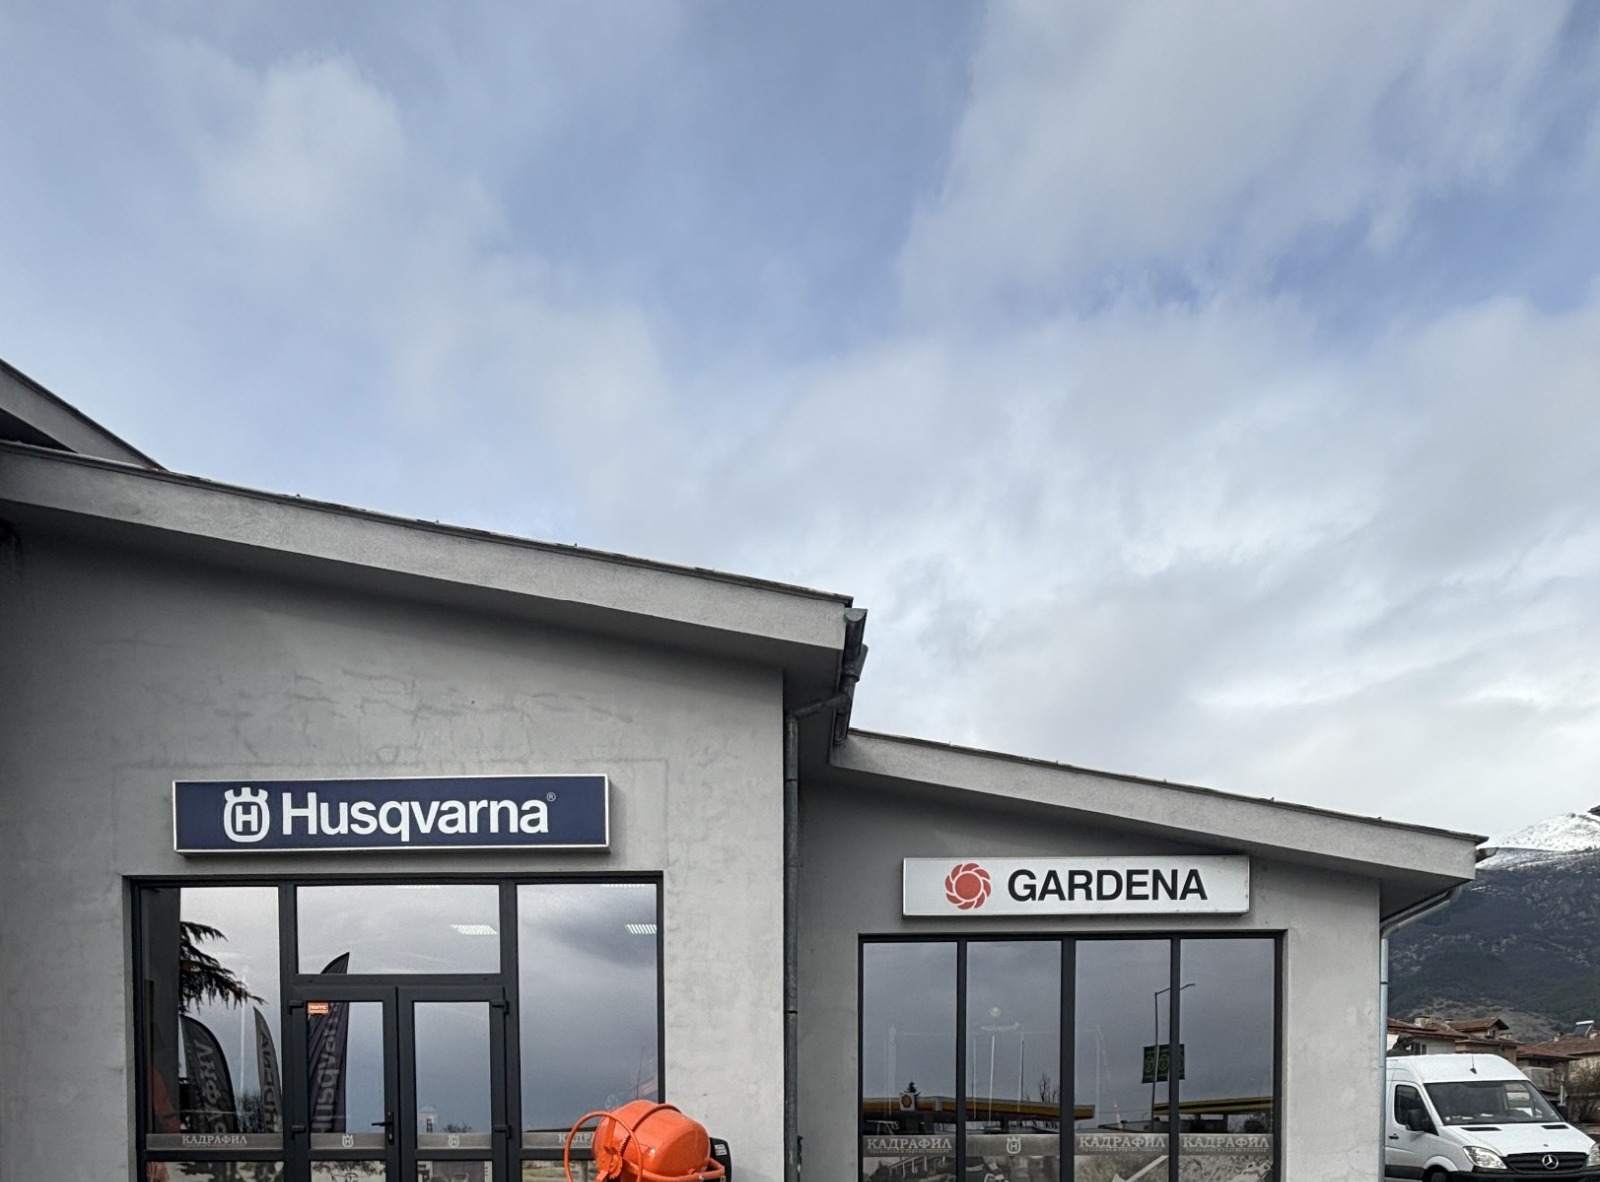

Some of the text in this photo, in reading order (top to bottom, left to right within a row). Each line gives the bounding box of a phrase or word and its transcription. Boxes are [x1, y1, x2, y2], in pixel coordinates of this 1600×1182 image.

[1007, 868, 1208, 902] GARDENA
[182, 1135, 248, 1145] КАДРАФИЛ
[867, 1137, 952, 1150] КАДРАФИЛ
[1079, 1136, 1166, 1149] КАДРАФИЛ
[1182, 1136, 1270, 1149] КАДРАФИЛ
